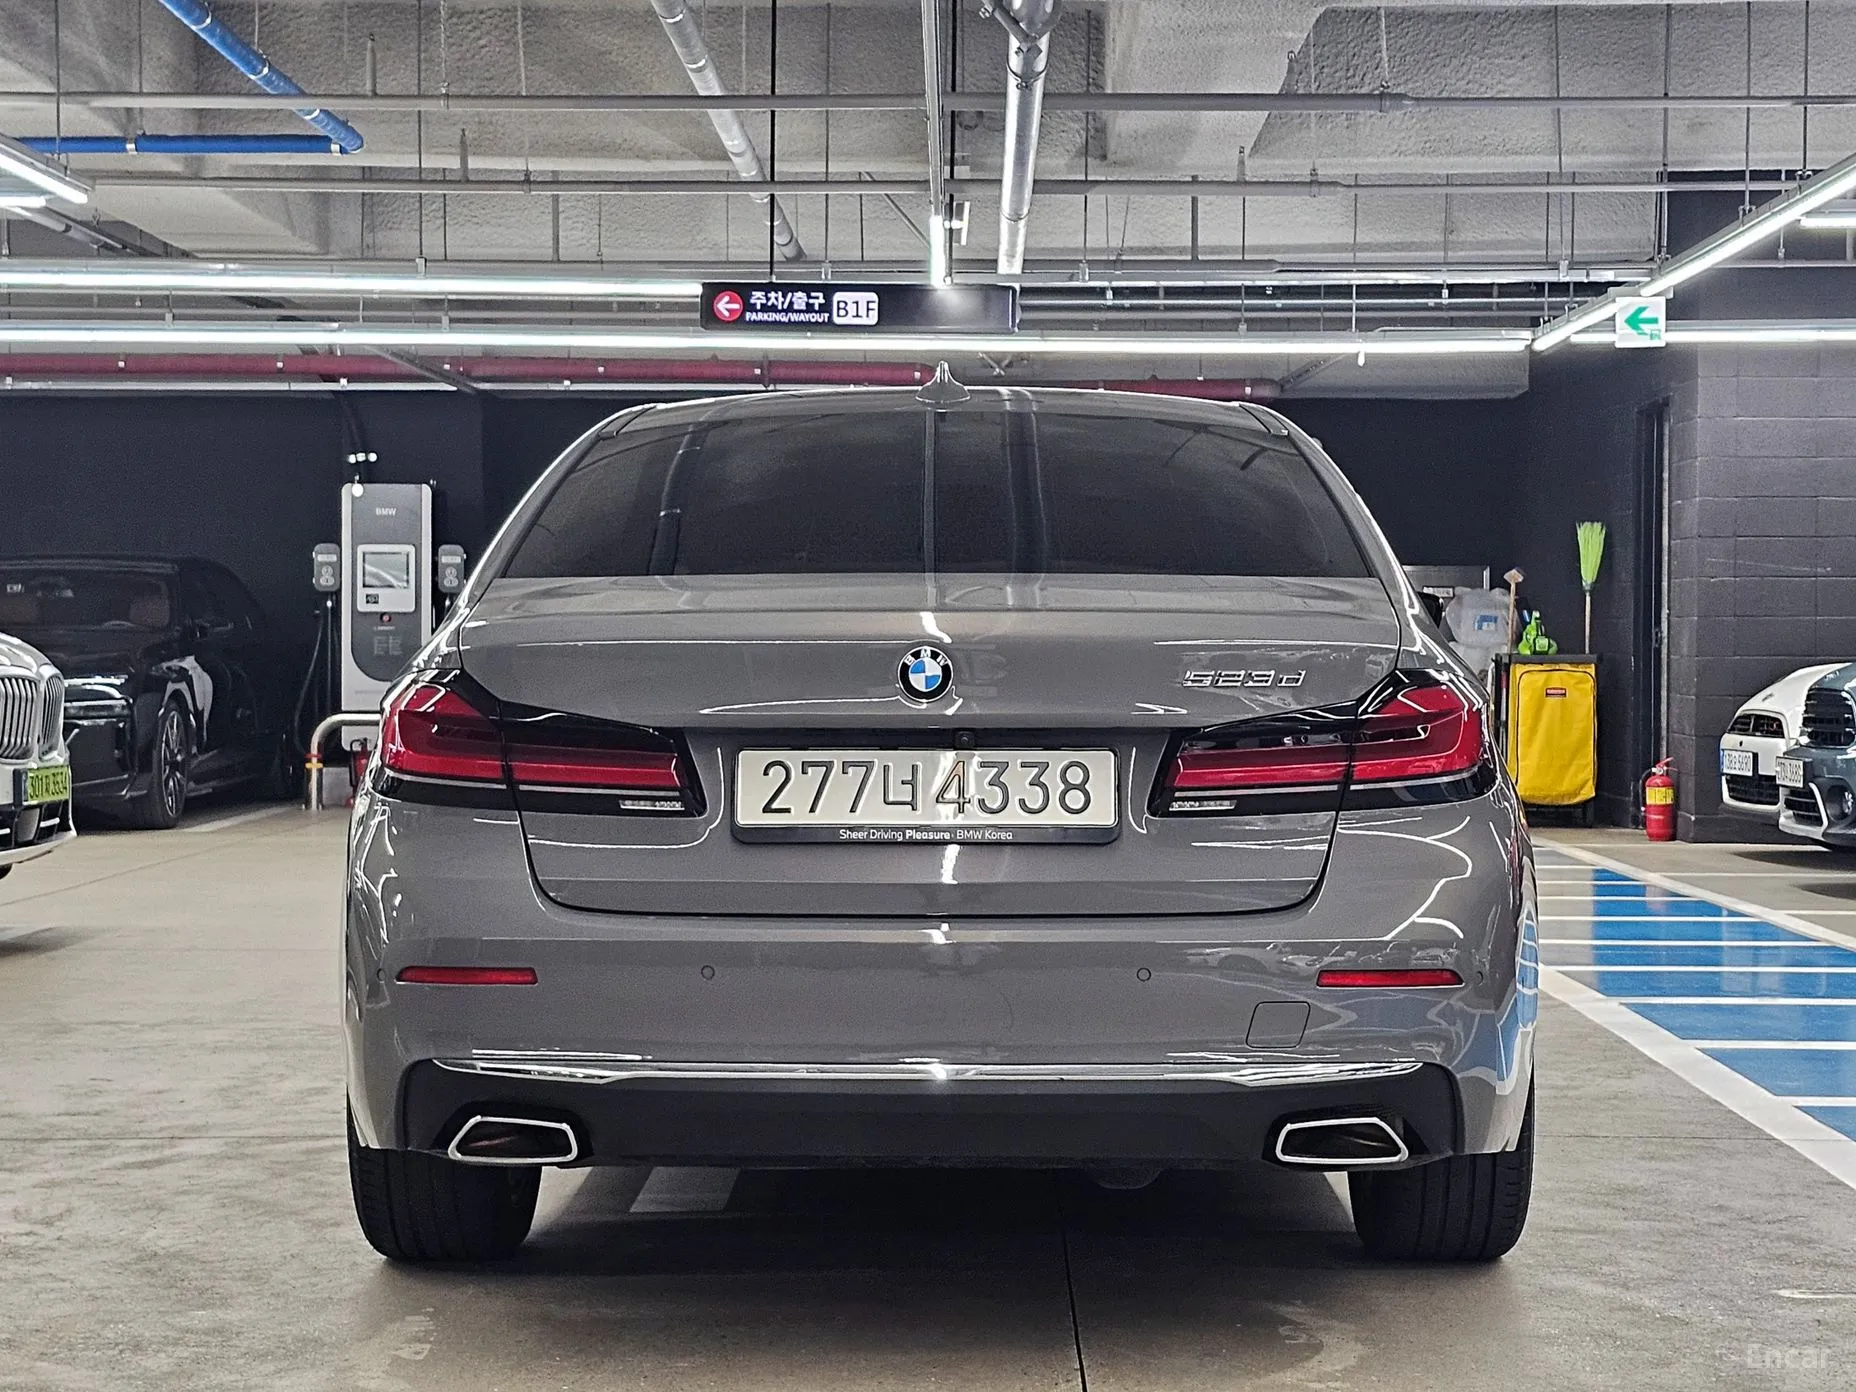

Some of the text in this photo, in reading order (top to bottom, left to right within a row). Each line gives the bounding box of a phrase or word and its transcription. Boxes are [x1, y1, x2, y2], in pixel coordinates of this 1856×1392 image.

[750, 291, 825, 310] 주차/출구
[836, 300, 877, 318] B1F
[745, 312, 830, 323] PARKING/WAYOUT
[904, 648, 948, 666] BMW
[1182, 670, 1307, 687] 523d
[761, 760, 1092, 814] 277너 4338
[839, 829, 868, 841] Sheer
[869, 829, 904, 843] Driving
[956, 829, 983, 841] BMW
[984, 829, 1013, 841] Korea
